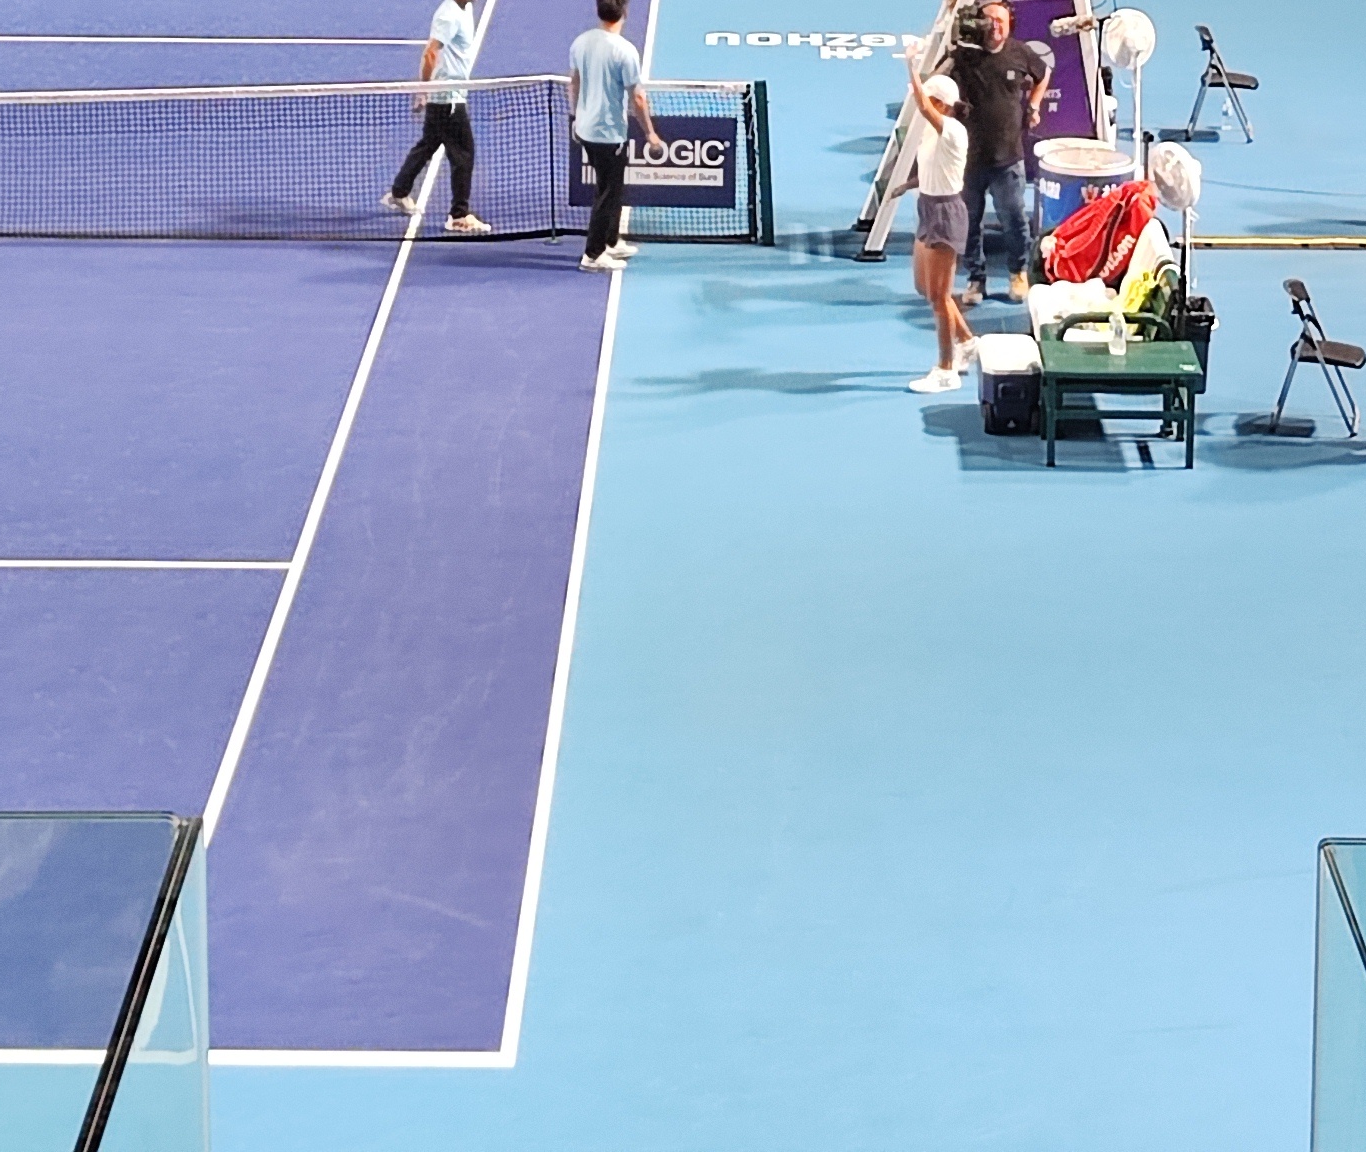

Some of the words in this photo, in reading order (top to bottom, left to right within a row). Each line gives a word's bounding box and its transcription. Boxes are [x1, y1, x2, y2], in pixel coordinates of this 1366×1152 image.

[582, 139, 725, 166] LOGIC
[635, 172, 651, 180] The
[653, 172, 686, 180] Science
[688, 172, 696, 180] of
